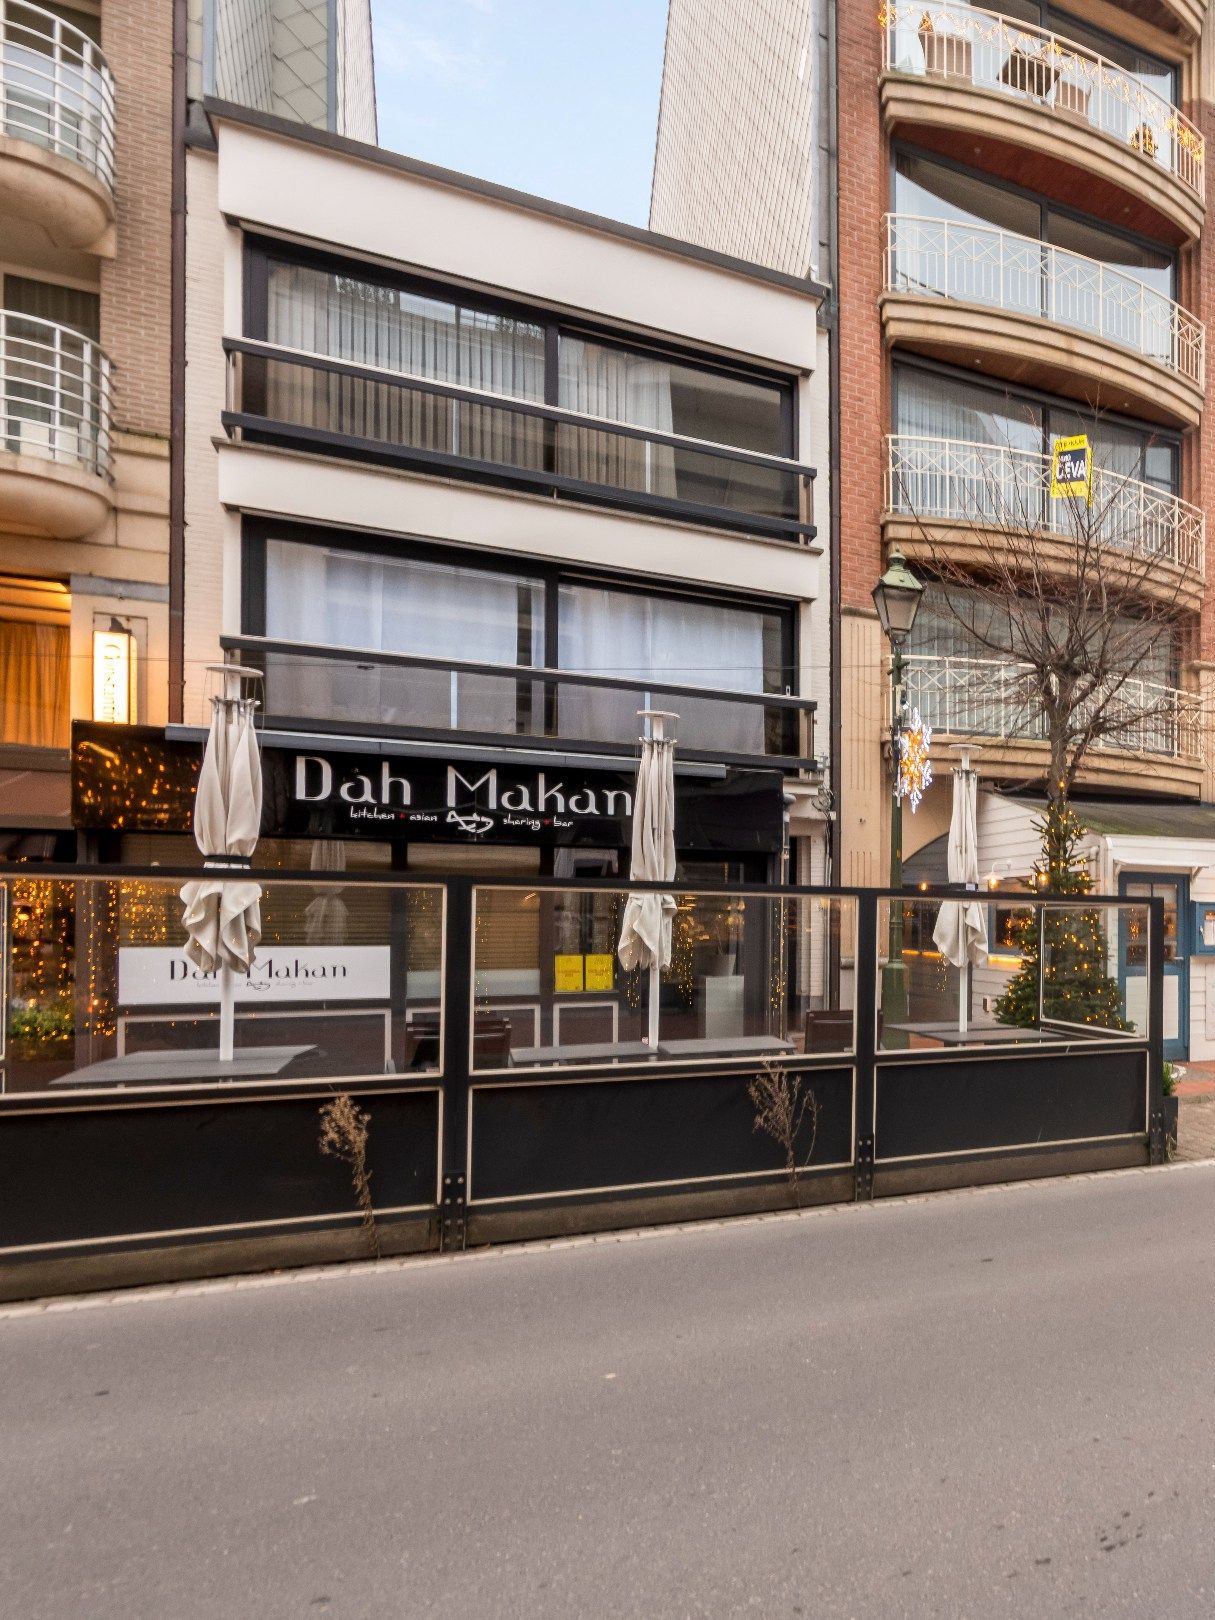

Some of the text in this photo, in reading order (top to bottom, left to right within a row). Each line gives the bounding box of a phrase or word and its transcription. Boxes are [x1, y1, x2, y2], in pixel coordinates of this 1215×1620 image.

[296, 755, 633, 816] Dah Makan
[350, 806, 574, 831] kitchen asian sharing bar
[246, 958, 348, 979] Makan
